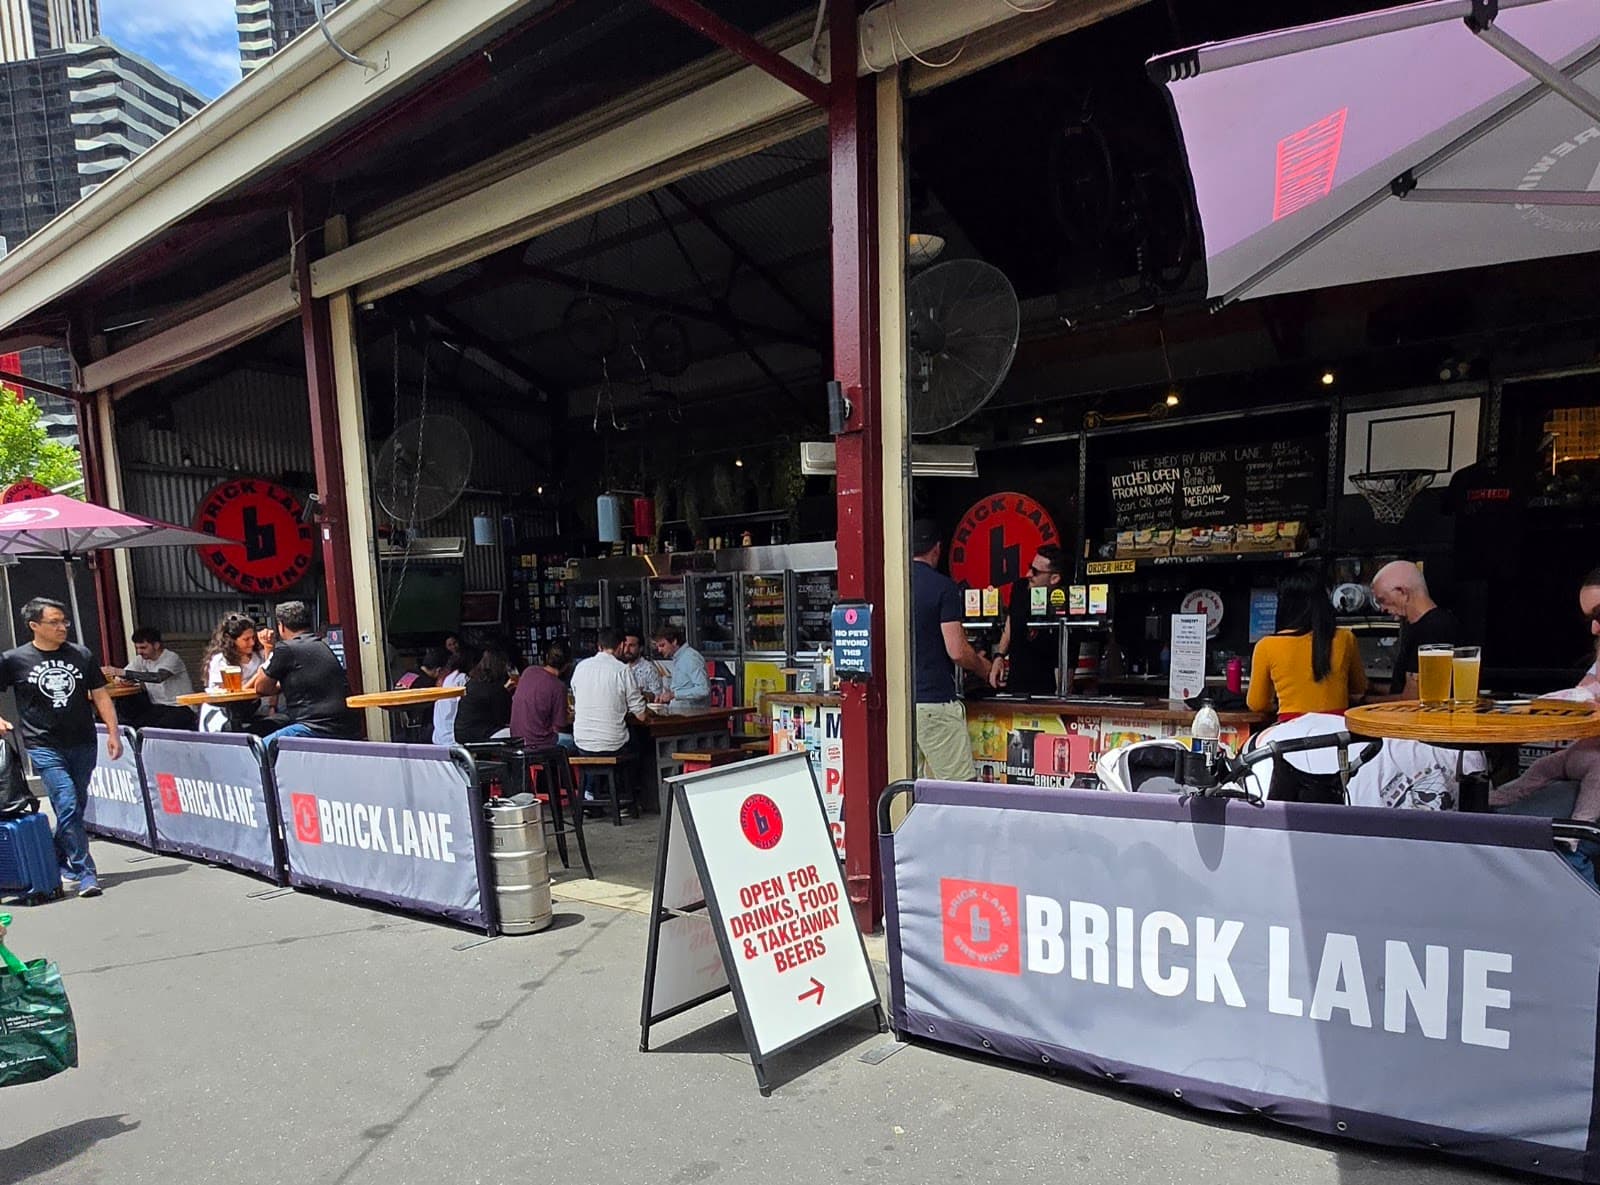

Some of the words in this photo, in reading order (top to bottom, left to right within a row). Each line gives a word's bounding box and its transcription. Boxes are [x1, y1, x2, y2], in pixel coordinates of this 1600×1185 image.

[1199, 449, 1226, 463] BRICK
[1234, 448, 1261, 461] LANE
[1111, 471, 1150, 488] KITCHEN
[1152, 467, 1180, 482] OPEN
[1183, 467, 1191, 478] 8
[1193, 466, 1214, 476] TAPS
[1112, 487, 1139, 500] FROM
[1139, 481, 1175, 496] MIDDAY
[1182, 483, 1222, 496] TAKEAWAY
[203, 481, 257, 537] BRICK
[1115, 501, 1136, 513] Scan
[1139, 497, 1152, 508] QR
[1154, 495, 1172, 507] code
[1184, 495, 1215, 508] MERCH
[952, 497, 1006, 564] BRICK
[1015, 499, 1055, 542] LAN
[211, 551, 308, 589] BREWING
[1087, 561, 1112, 574] ORDER
[1113, 560, 1135, 572] HERE
[840, 659, 865, 667] POINT
[1070, 723, 1086, 731] ON
[1089, 723, 1101, 731] TA
[1077, 716, 1100, 724] NOW
[1007, 766, 1027, 777] BRICK
[1034, 775, 1061, 788] BRICK
[105, 767, 137, 805] LANE
[174, 776, 222, 819] BRICK
[217, 783, 258, 828] LANE
[318, 799, 388, 853] BRICK
[388, 807, 456, 863] LANE
[739, 875, 783, 909] OPEN
[787, 864, 820, 893] FOR
[729, 898, 799, 938] DRINKS,
[798, 881, 839, 915] FOOD
[742, 937, 758, 960] &
[757, 904, 840, 953] TAKEAWAY
[774, 936, 826, 974] BEERS
[1025, 894, 1247, 1009] BRICK
[1268, 926, 1513, 1050] LANE
